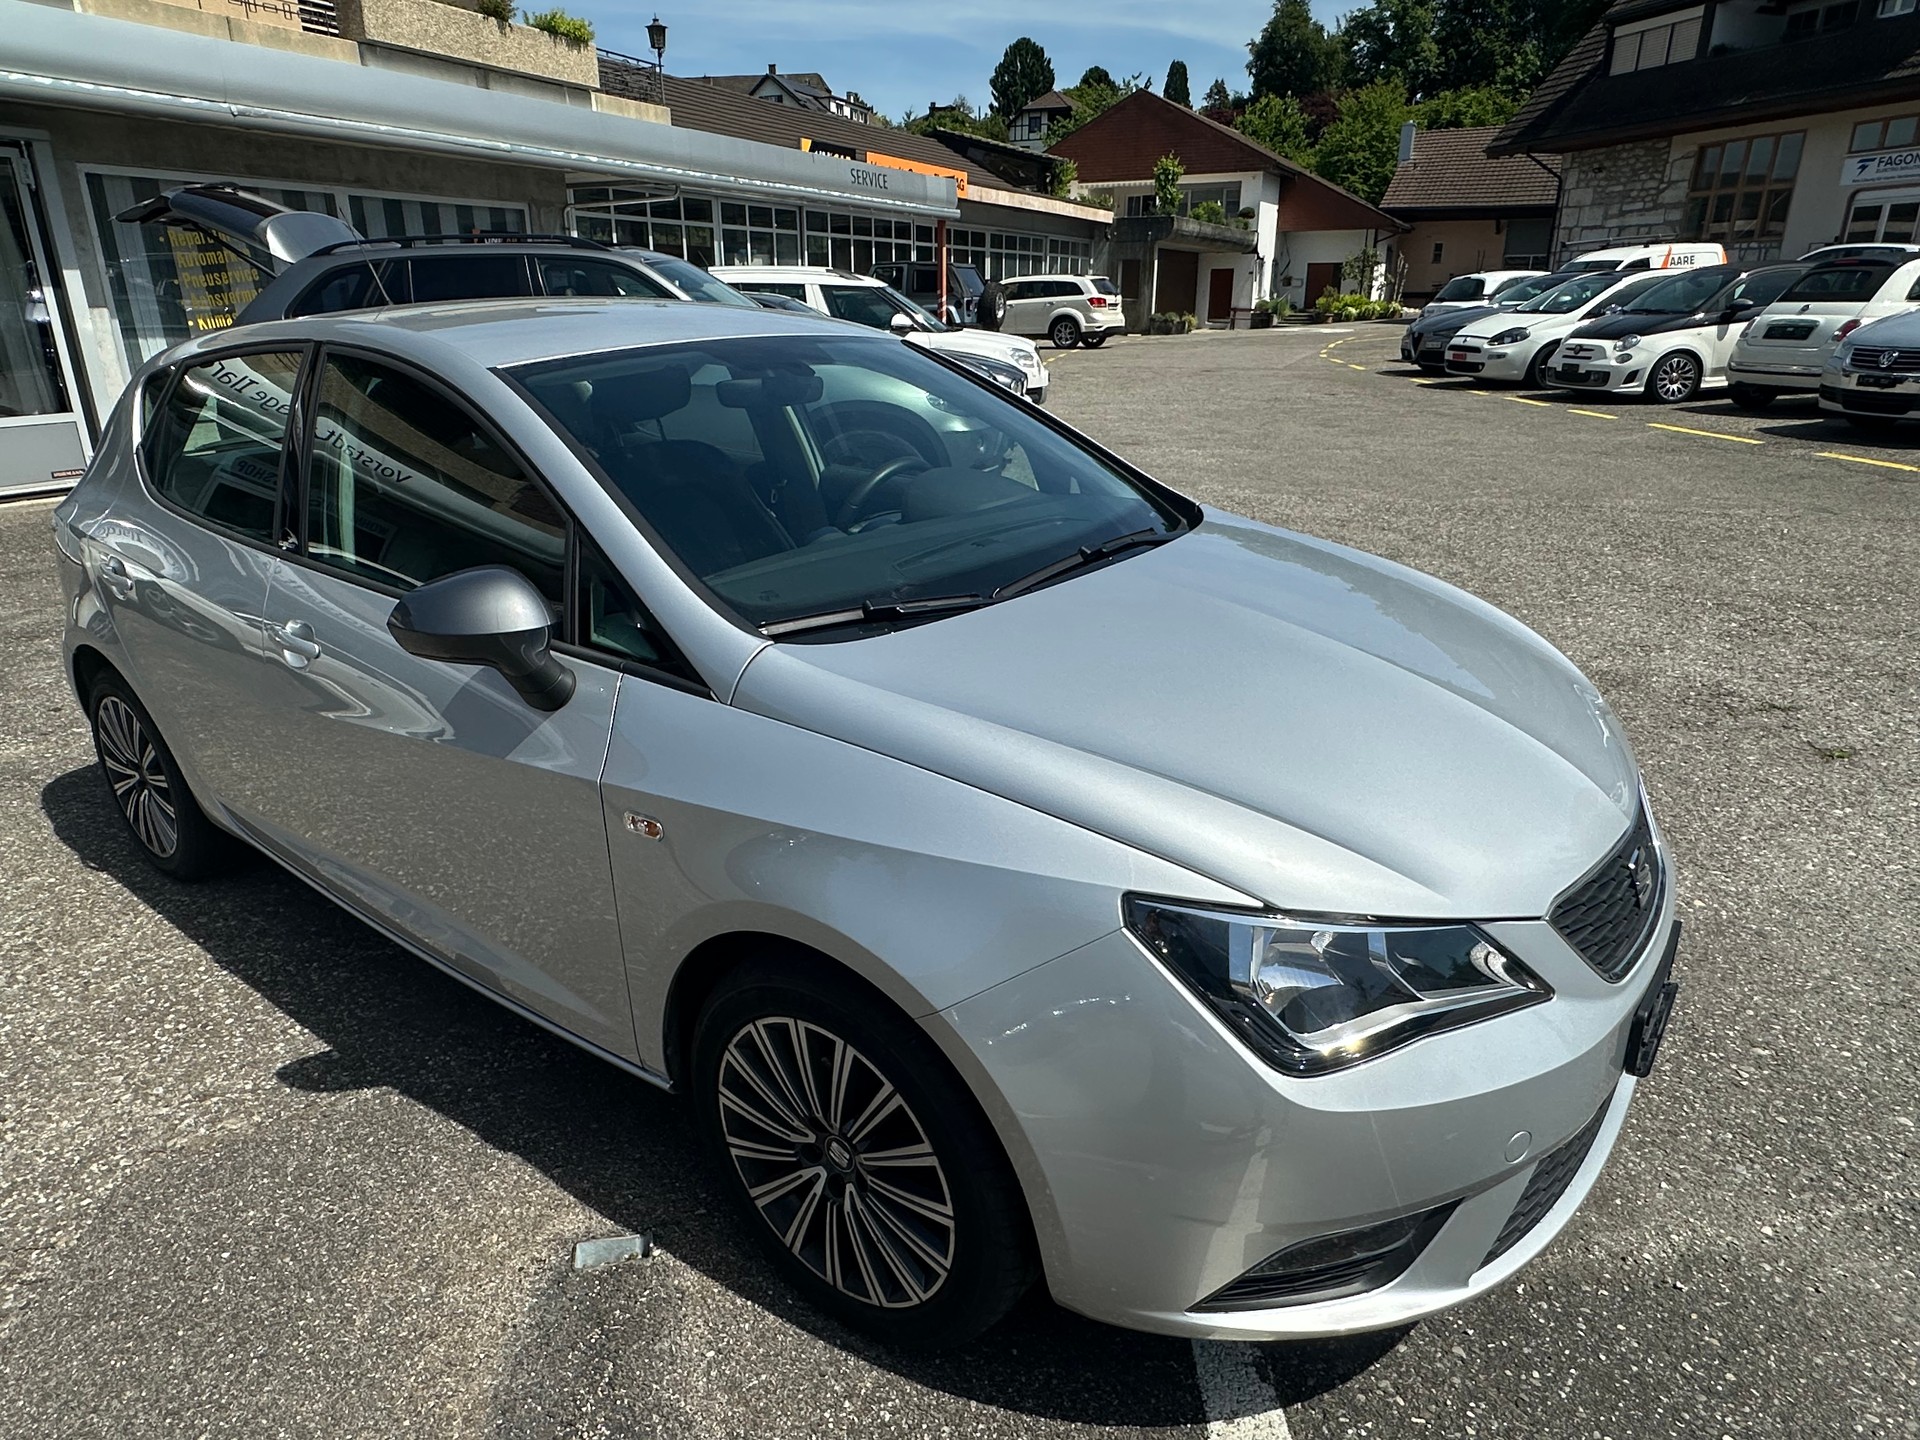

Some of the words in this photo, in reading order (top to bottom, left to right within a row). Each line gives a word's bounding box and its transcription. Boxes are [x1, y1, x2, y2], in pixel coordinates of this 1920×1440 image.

[850, 168, 888, 190] SERVICE
[1669, 255, 1695, 266] AARE
[182, 268, 260, 289] Pneuservice
